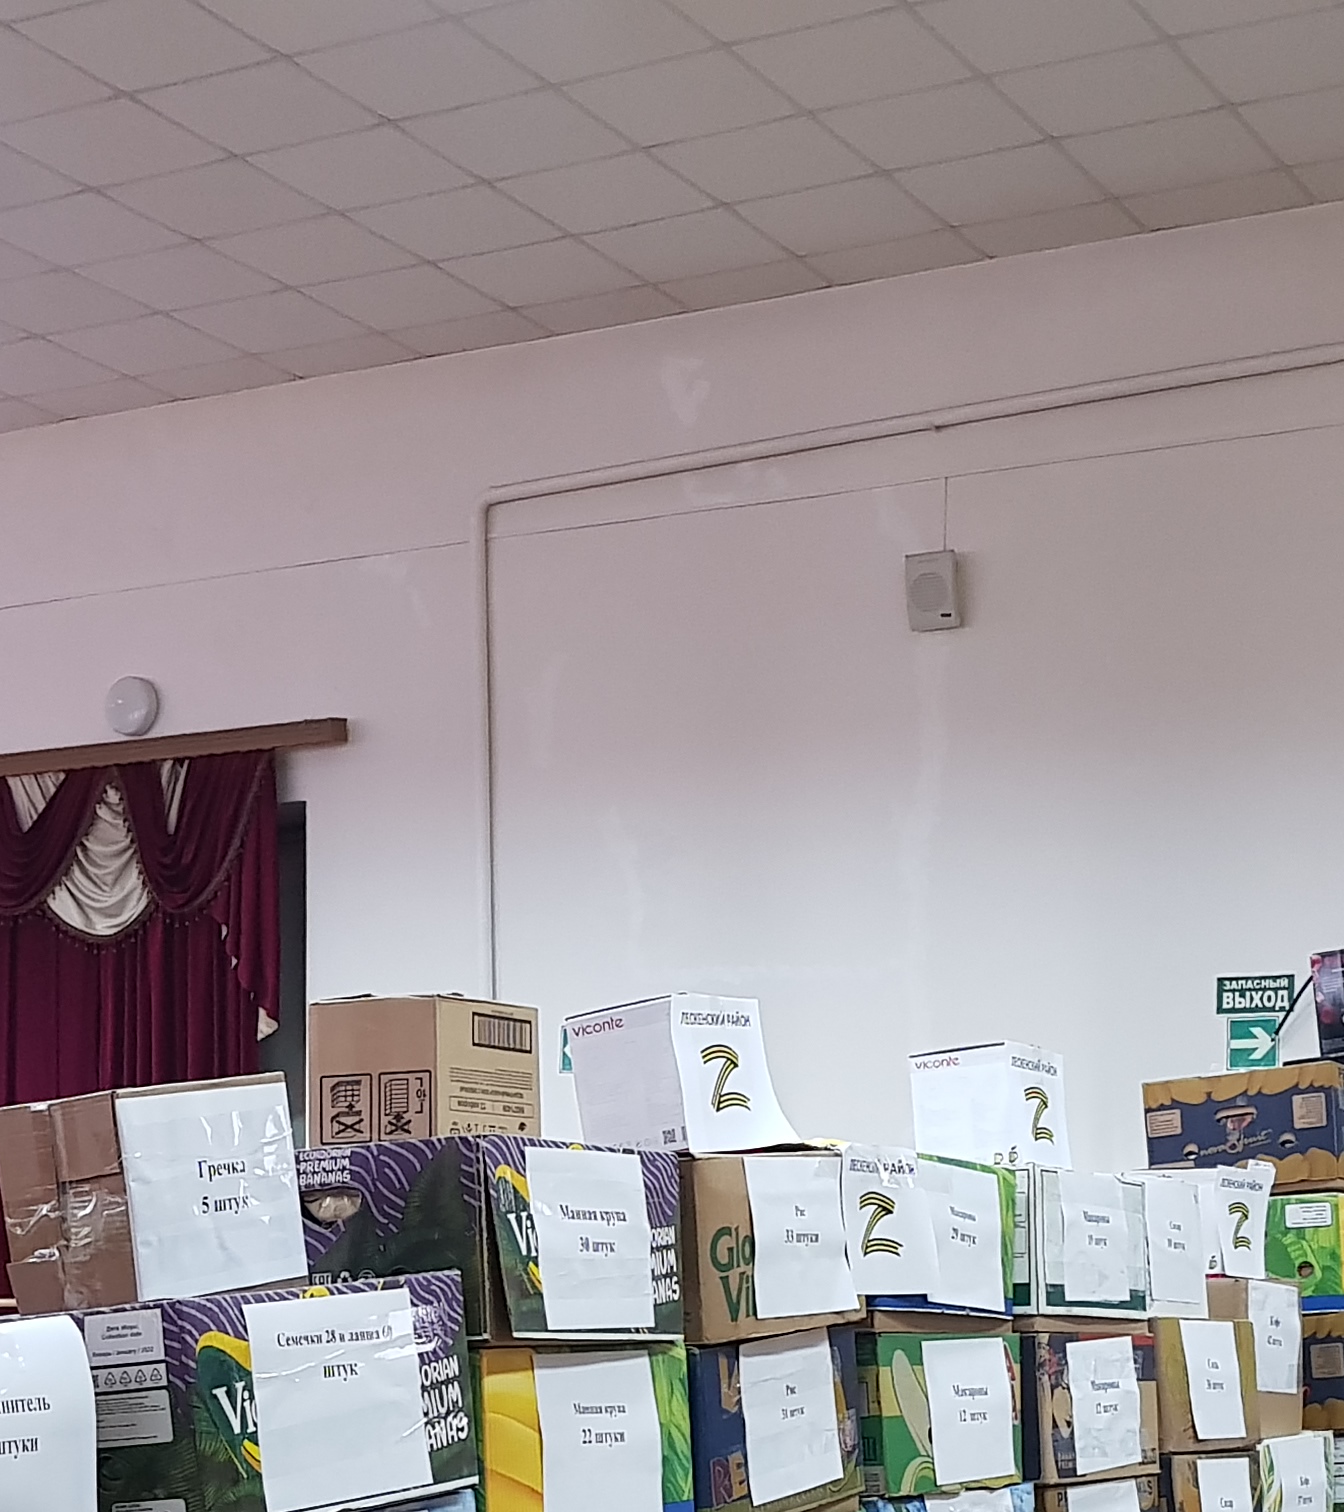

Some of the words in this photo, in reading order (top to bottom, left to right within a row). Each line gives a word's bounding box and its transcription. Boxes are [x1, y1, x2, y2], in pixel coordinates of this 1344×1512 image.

[1223, 976, 1289, 991] ЗАПАСНЫЙ
[1222, 990, 1290, 1011] ВЫХОД
[571, 1015, 625, 1039] viconte
[197, 1159, 246, 1183] Гречка
[299, 1158, 350, 1174] PREMIUM
[299, 1170, 351, 1185] BANANAS
[201, 1195, 210, 1215] 5
[213, 1195, 249, 1215] штук
[558, 1203, 599, 1222] Манная
[598, 1210, 628, 1227] крупа
[784, 1228, 795, 1244] 33
[795, 1232, 820, 1247] штуки
[591, 1241, 616, 1258] штук
[276, 1332, 323, 1348] Семечки
[324, 1329, 337, 1344] 28
[322, 1362, 359, 1382] штук
[785, 1384, 797, 1397] Рис
[952, 1384, 989, 1401] Макароны
[572, 1402, 604, 1415] Манная
[604, 1404, 627, 1418] крупа
[958, 1408, 967, 1423] 12
[969, 1411, 988, 1425] штук
[581, 1428, 593, 1445] 22
[594, 1431, 626, 1448] штуки
